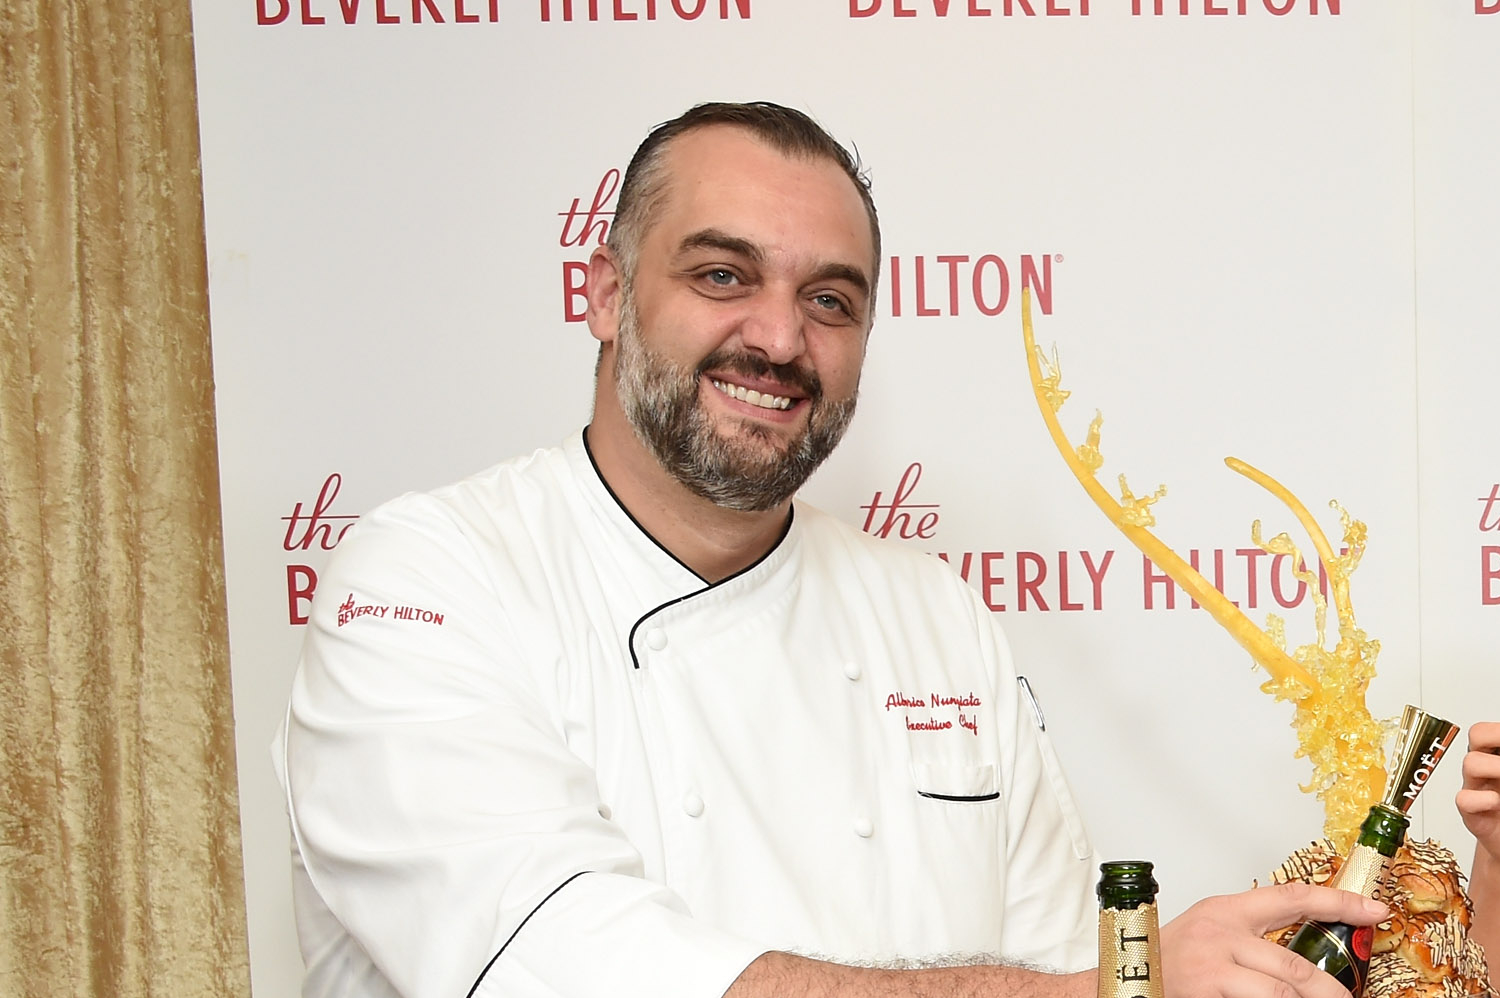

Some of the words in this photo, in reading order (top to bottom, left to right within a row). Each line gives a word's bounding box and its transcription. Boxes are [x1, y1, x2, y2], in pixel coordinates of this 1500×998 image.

[558, 168, 620, 246] th
[859, 461, 940, 540] the
[938, 550, 1115, 613] ERLY
[337, 605, 389, 627] BEVERLY
[393, 606, 445, 626] HILTON
[958, 713, 978, 736] Chef
[1402, 736, 1447, 801] MOËT
